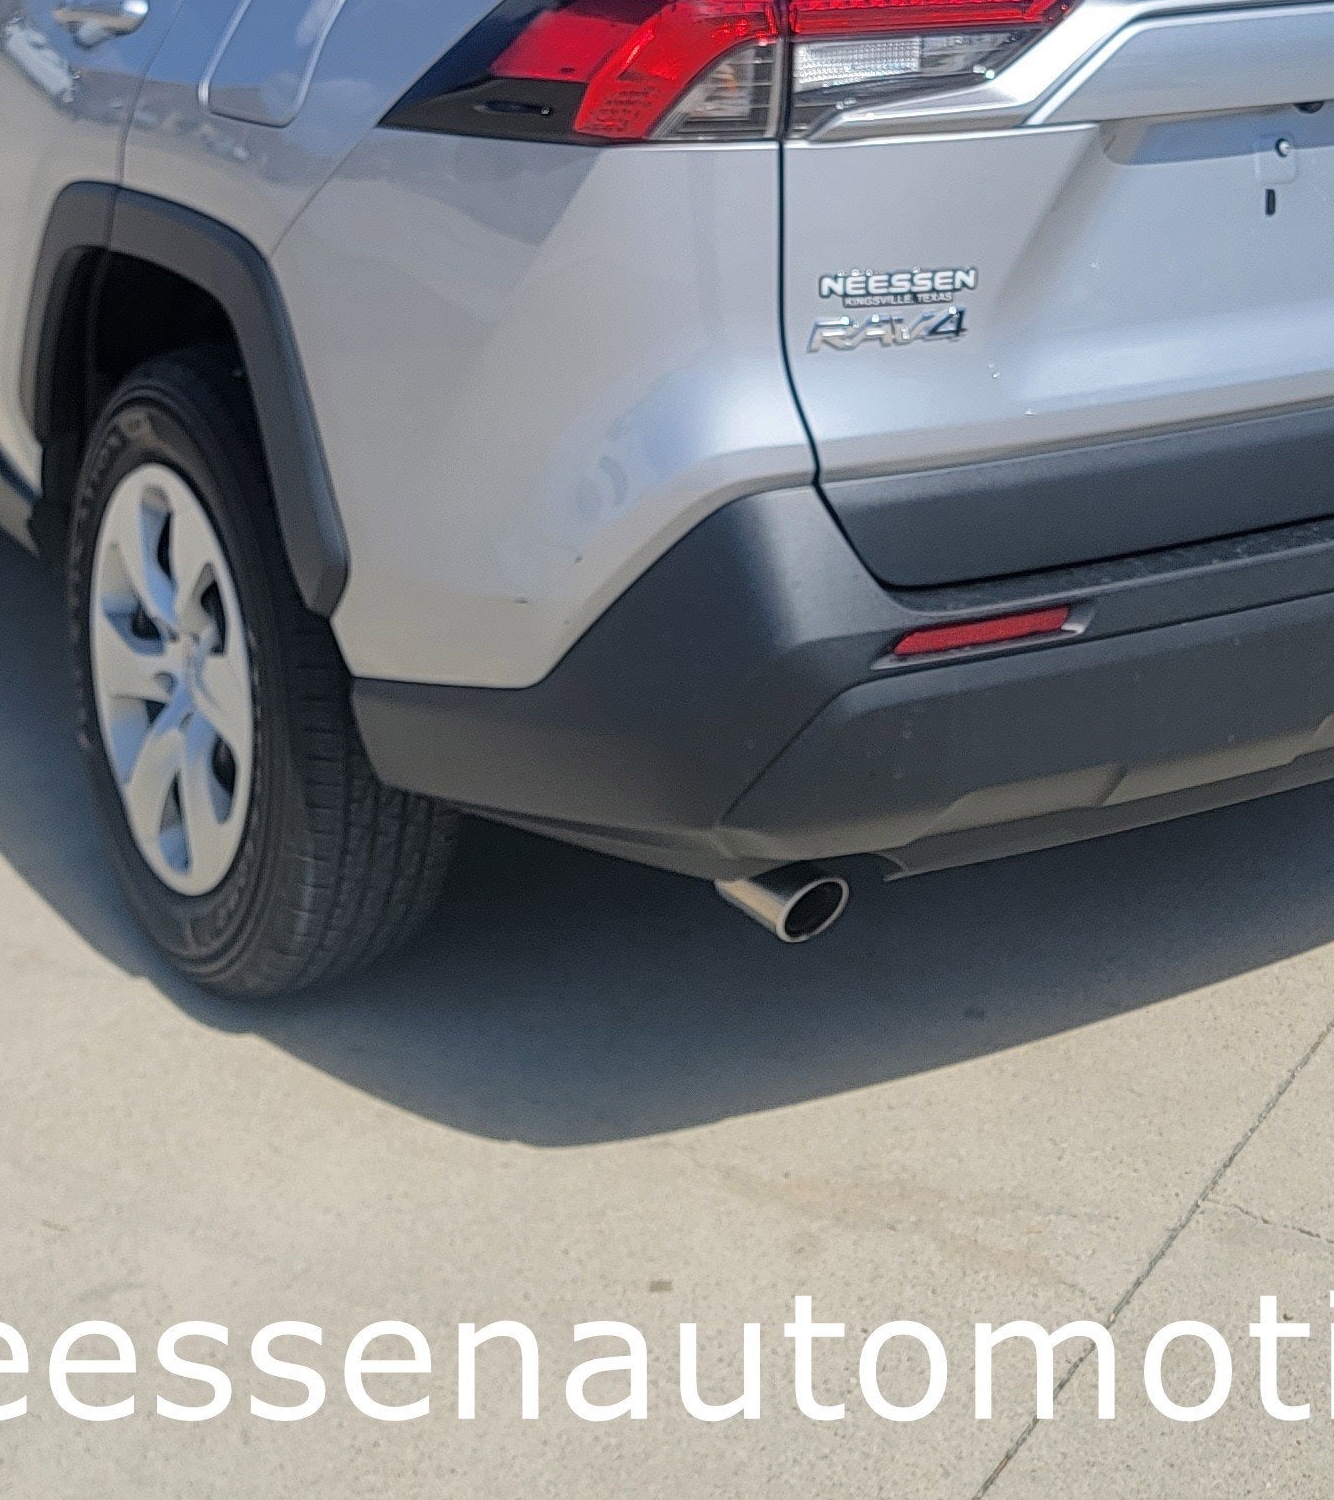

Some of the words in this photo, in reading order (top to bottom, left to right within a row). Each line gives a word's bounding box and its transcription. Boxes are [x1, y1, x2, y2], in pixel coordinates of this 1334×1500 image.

[820, 268, 977, 297] NEESSEN
[917, 292, 953, 303] TEXAS
[806, 306, 968, 354] RAV4
